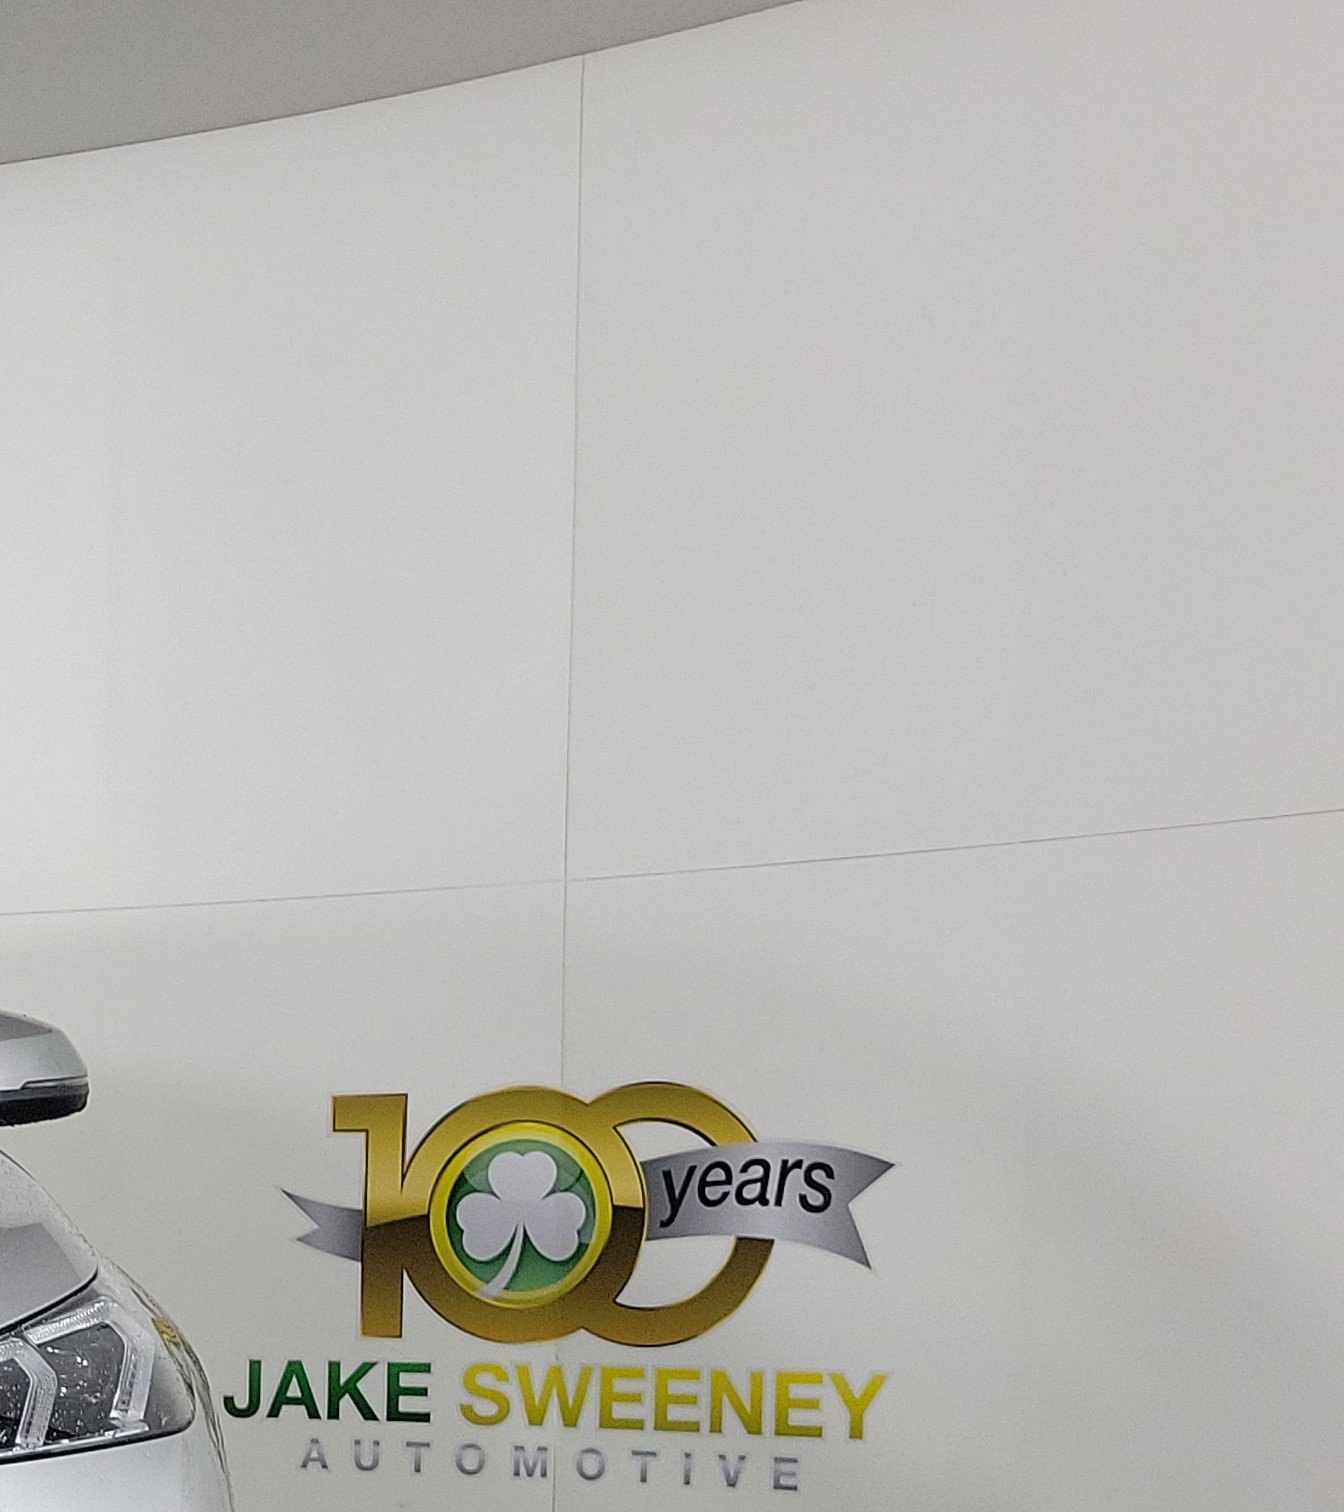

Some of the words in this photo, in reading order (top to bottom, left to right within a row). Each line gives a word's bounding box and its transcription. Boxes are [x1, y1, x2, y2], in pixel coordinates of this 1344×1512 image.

[331, 1080, 776, 1347] 100
[658, 1158, 836, 1228] years
[222, 1359, 432, 1423] JAKE
[460, 1362, 887, 1440] SWEENEY
[300, 1437, 799, 1492] AUTOMOTIVE
